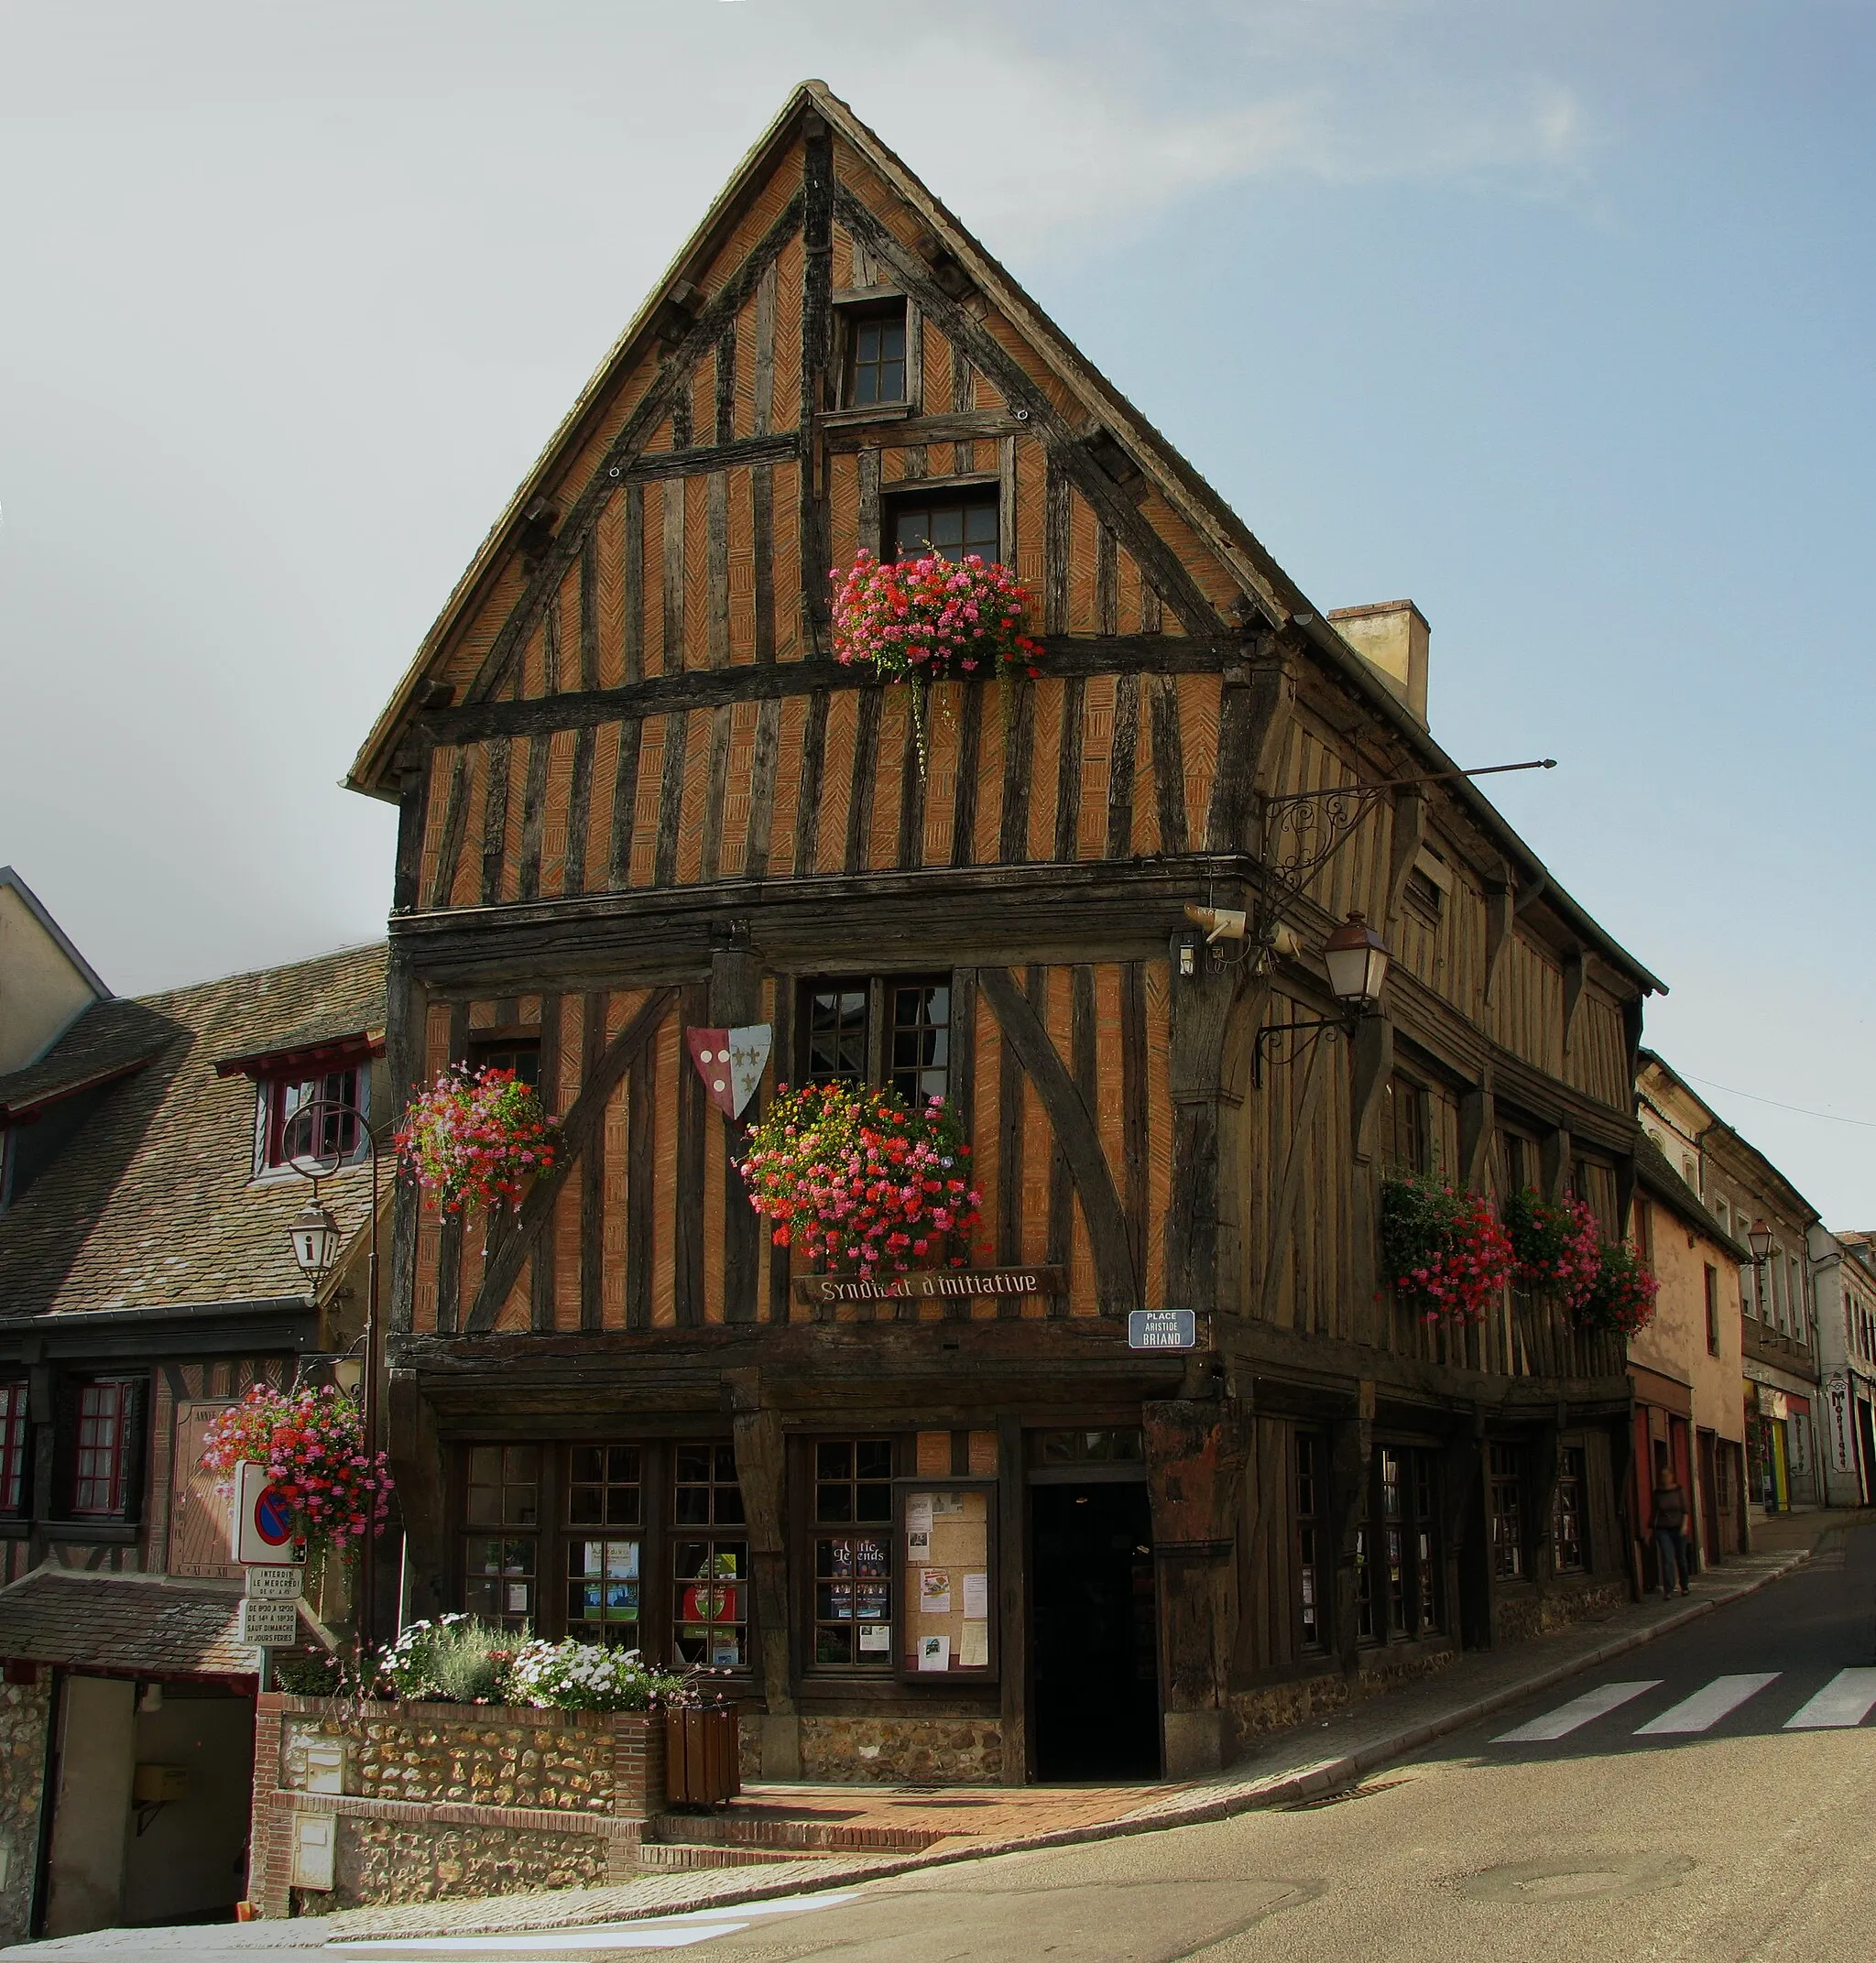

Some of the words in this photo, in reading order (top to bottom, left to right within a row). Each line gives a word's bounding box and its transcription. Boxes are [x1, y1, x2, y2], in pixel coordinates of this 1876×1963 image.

[922, 1273, 1037, 1296] d'initiative
[1147, 1312, 1176, 1320] PLACE
[1145, 1322, 1178, 1332] ARISTIDE
[1143, 1333, 1181, 1346] BRIAND
[834, 1549, 884, 1565] Leends
[217, 1566, 228, 1577] XII
[260, 1570, 292, 1578] INTERDIT
[264, 1579, 300, 1587] MERCREDI
[246, 1624, 264, 1632] SAUF
[264, 1624, 294, 1632] DIMANCHE
